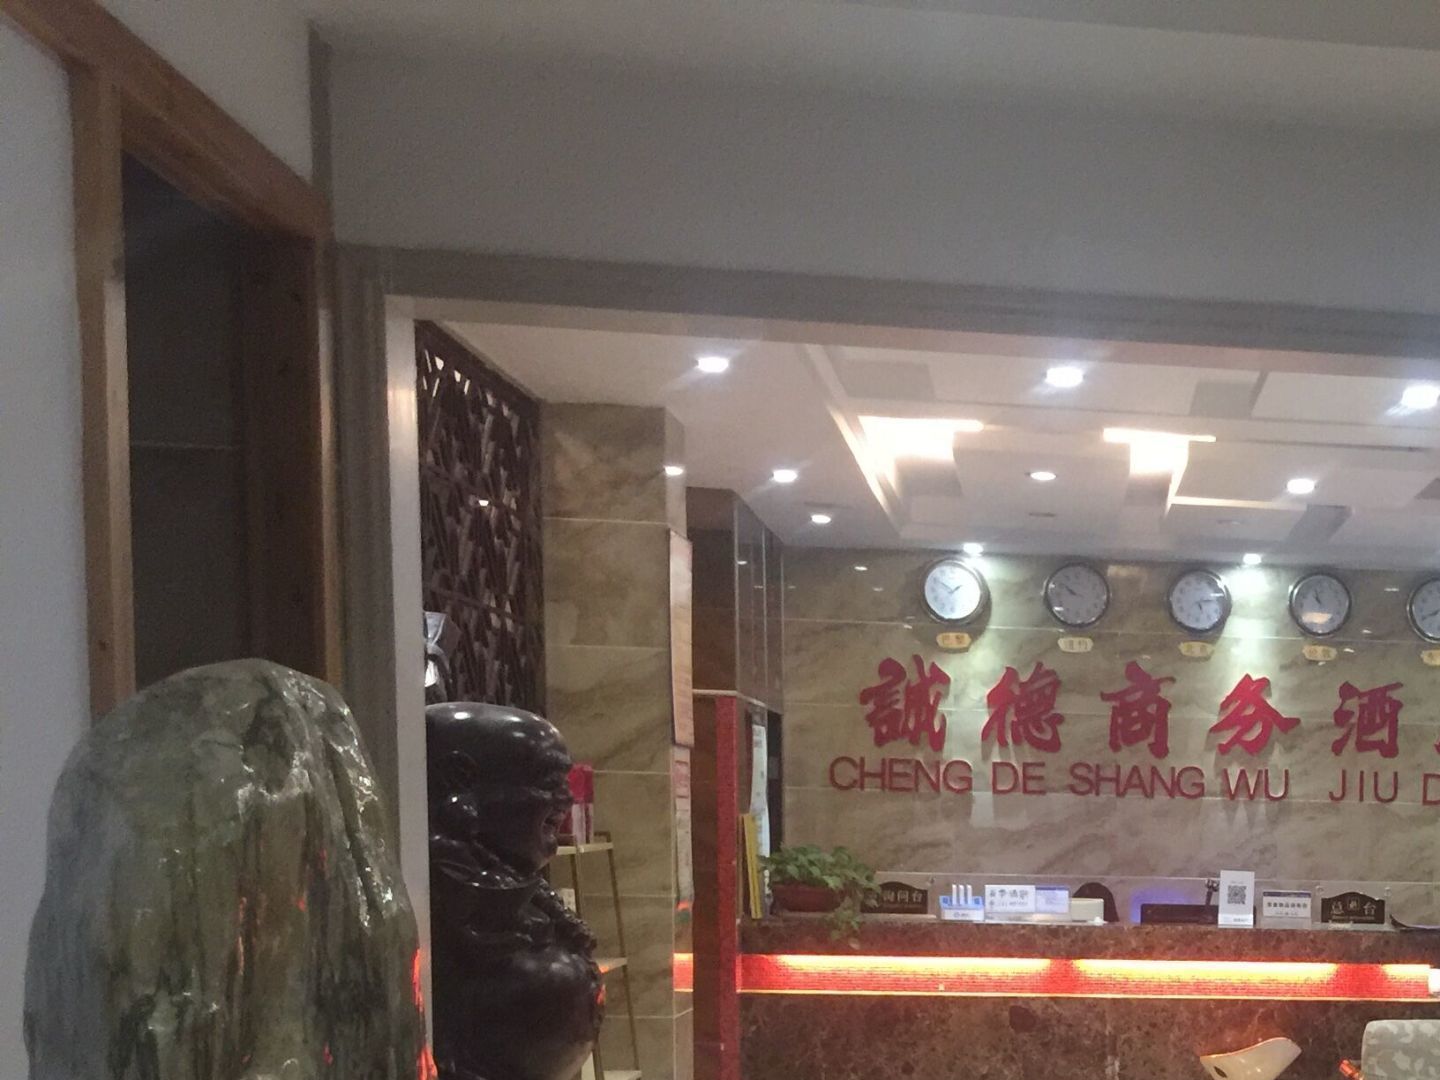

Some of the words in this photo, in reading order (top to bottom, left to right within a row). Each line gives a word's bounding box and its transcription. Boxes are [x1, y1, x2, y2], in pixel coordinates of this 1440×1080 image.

[829, 756, 973, 794] CHENG
[991, 761, 1047, 796] DE
[1069, 762, 1205, 799] SHANG
[1223, 768, 1290, 801] WU
[1328, 768, 1399, 803] JIU
